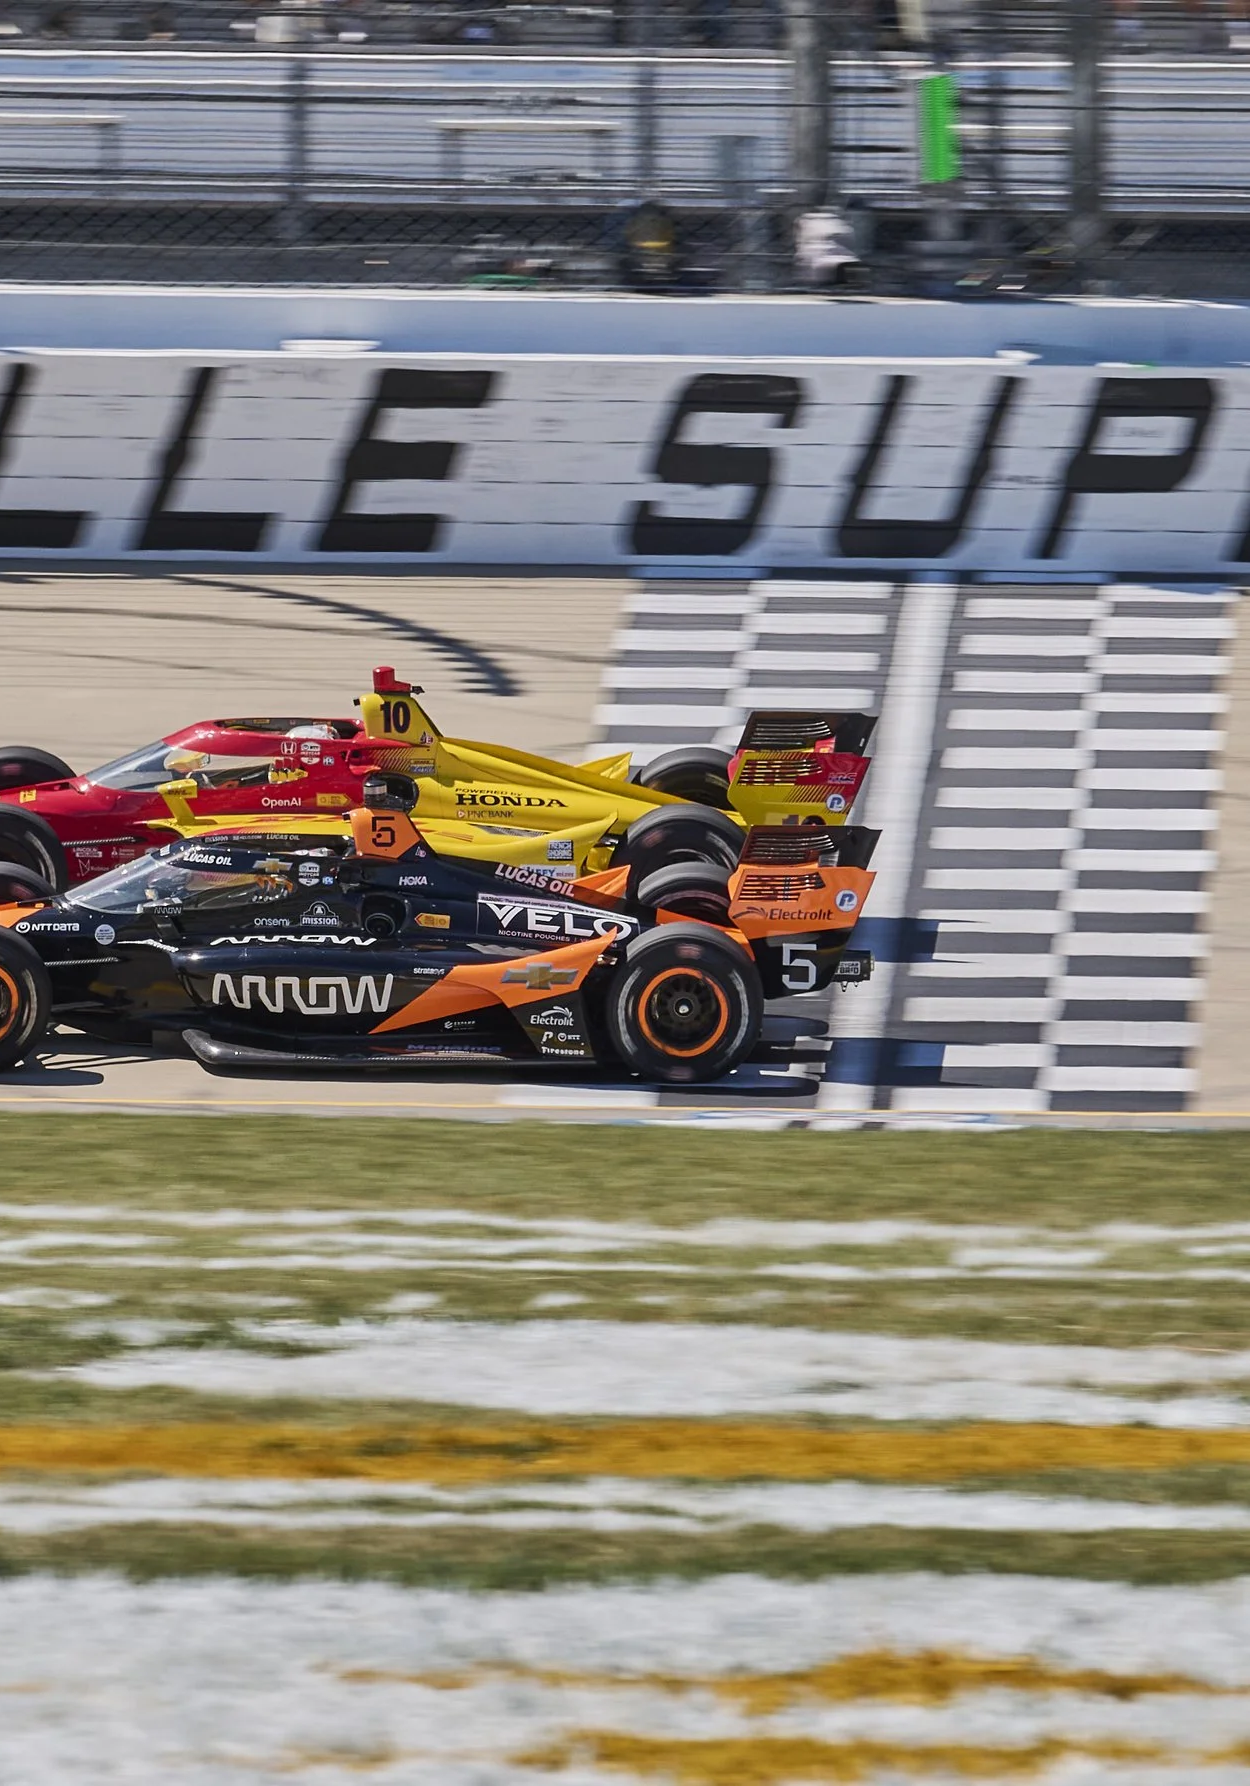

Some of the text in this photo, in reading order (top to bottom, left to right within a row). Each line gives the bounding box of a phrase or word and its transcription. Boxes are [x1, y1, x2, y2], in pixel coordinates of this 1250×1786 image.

[625, 371, 1250, 563] SUP
[380, 701, 410, 734] 10
[455, 788, 508, 796] POWERED
[261, 797, 301, 808] OpenAI
[455, 793, 567, 808] HONDA
[371, 816, 395, 848] 5
[184, 852, 232, 866] LUCAS OIL
[399, 876, 428, 885] HOKA
[495, 863, 575, 897] LUCAS OIL
[154, 906, 182, 915] ARROW
[768, 908, 834, 921] Electrolit
[254, 917, 290, 926] onsemi
[302, 916, 338, 925] MISSION
[485, 903, 632, 941] VELO
[210, 935, 377, 946] ARROW
[498, 929, 533, 938] NICOTINE
[534, 933, 570, 942] POUCHES
[413, 967, 445, 975] stratasys
[782, 943, 817, 990] 5
[212, 973, 394, 1015] ARROW
[530, 1014, 574, 1026] Electrolit
[541, 1046, 585, 1056] Firestone
